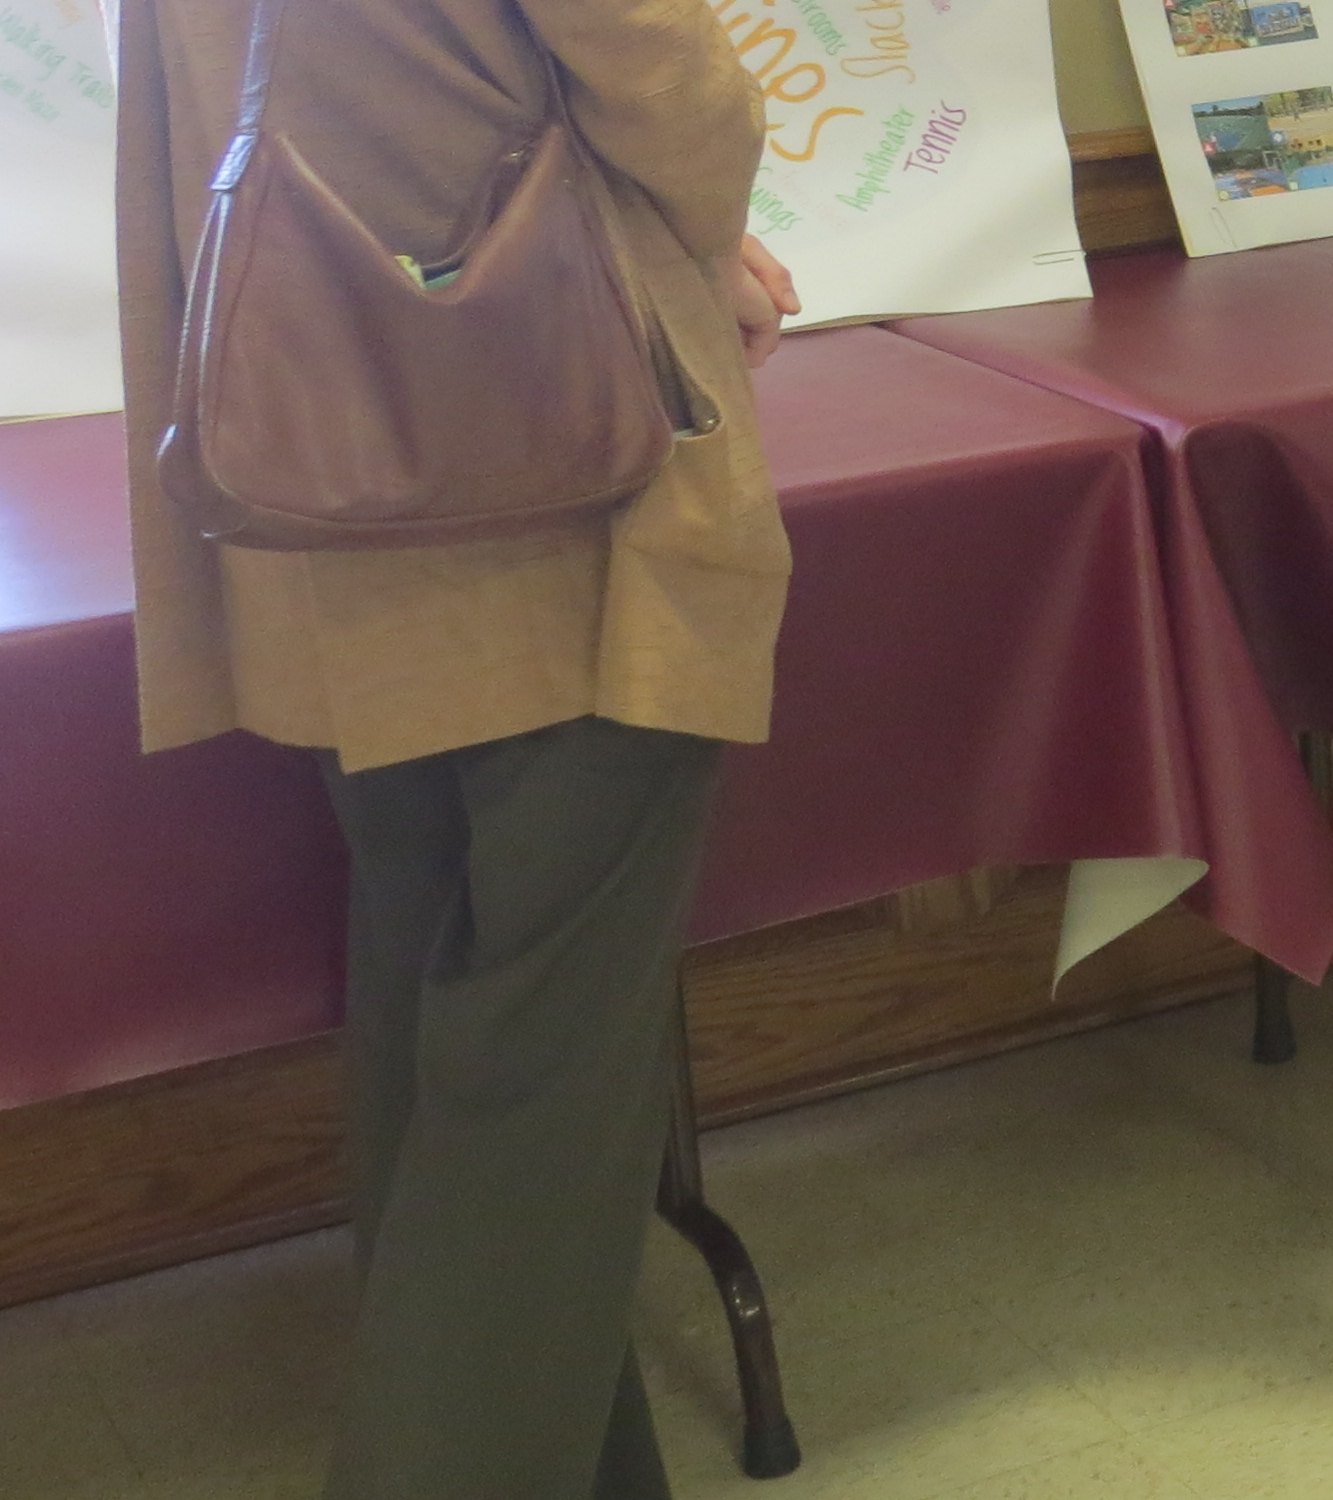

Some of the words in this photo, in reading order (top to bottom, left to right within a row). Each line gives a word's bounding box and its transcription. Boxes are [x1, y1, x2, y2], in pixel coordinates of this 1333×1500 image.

[836, 103, 916, 212] Amphitheater
[903, 99, 967, 174] Tennis
[749, 166, 803, 235] wings
